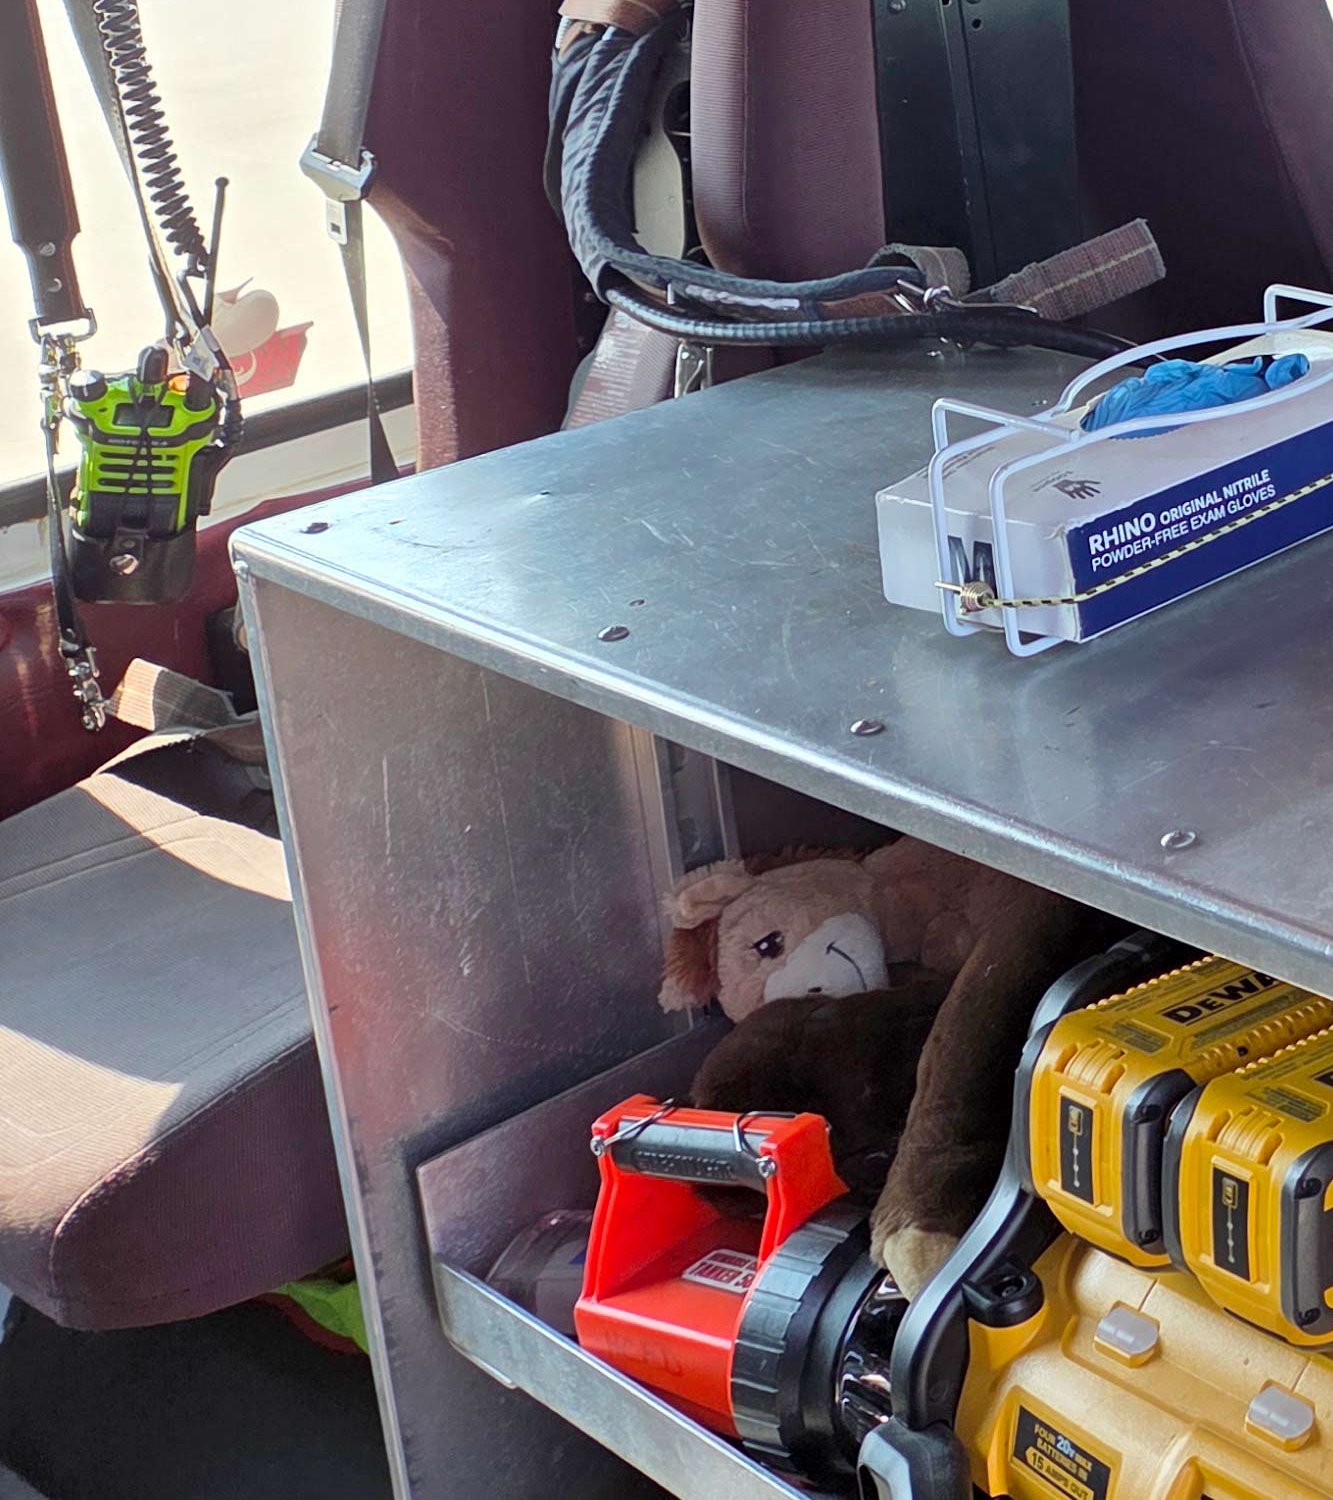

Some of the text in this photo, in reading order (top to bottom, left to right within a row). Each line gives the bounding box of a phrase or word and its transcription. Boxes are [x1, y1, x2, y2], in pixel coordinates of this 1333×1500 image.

[1088, 469, 1271, 555] RHINO ORIGINAL NITRILE
[1091, 483, 1277, 572] POWDER-FREE EXAM GLOVES
[688, 1262, 743, 1284] TANKER
[1034, 1424, 1057, 1445] FOUR
[1036, 1437, 1078, 1475] BATTERIES
[1031, 1452, 1089, 1500] 15 AMPS OUT
